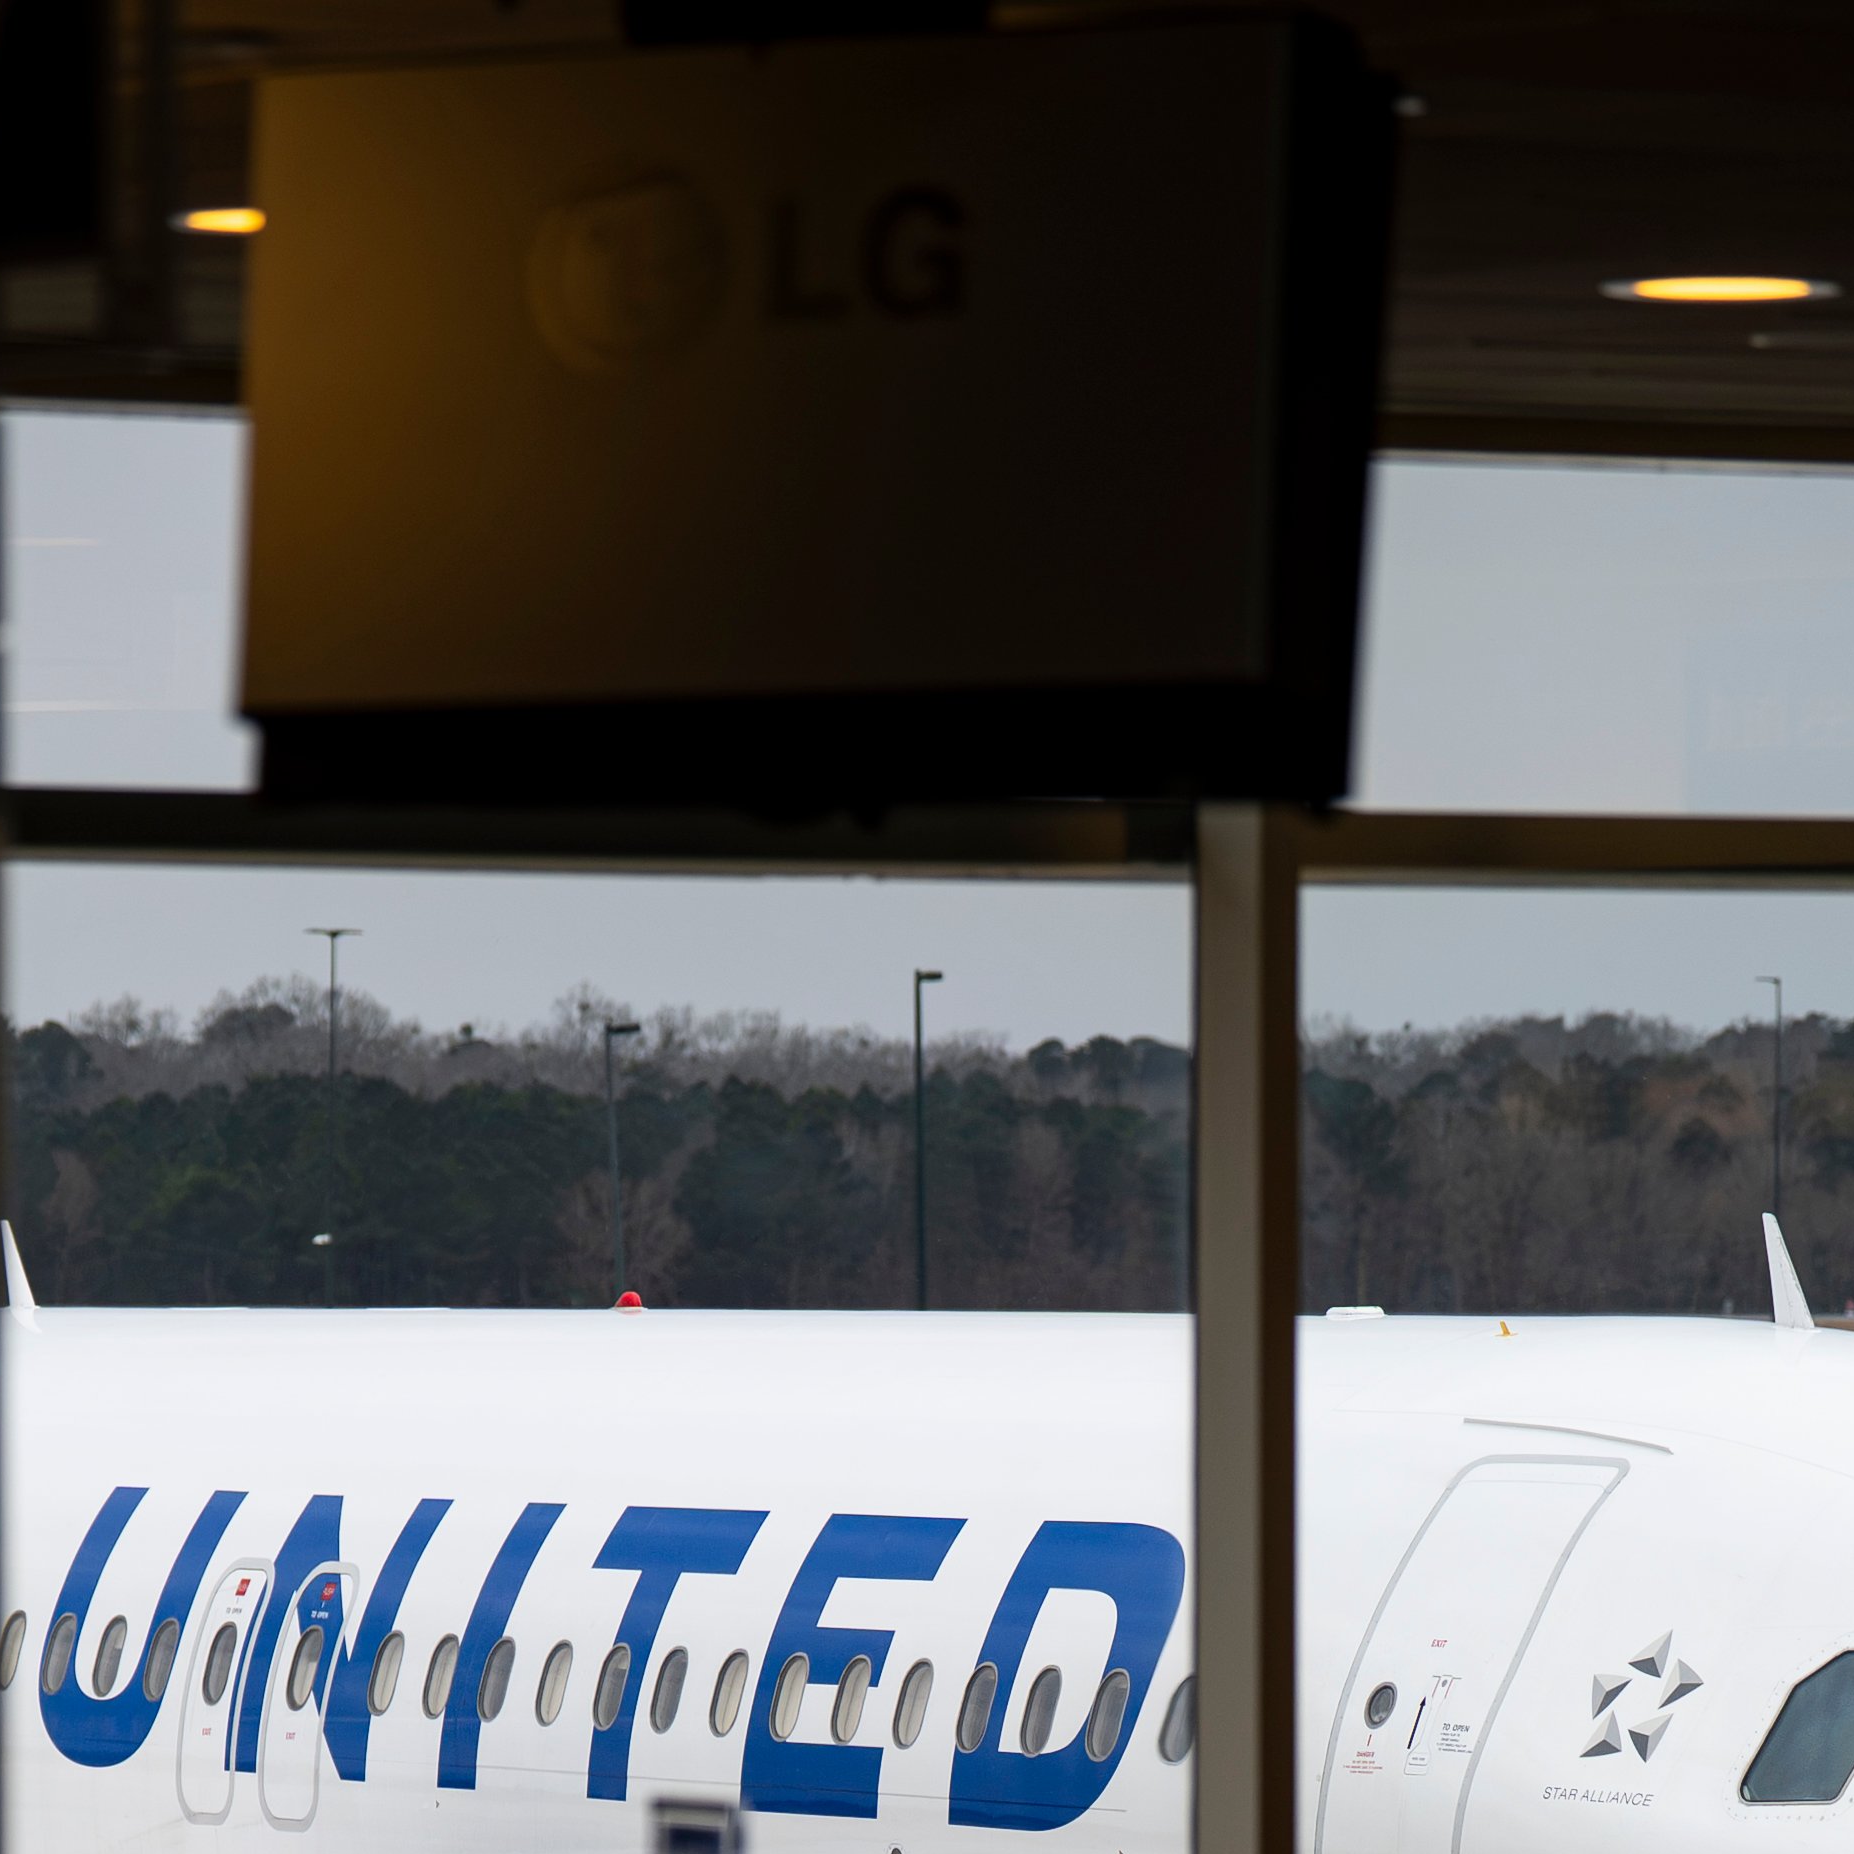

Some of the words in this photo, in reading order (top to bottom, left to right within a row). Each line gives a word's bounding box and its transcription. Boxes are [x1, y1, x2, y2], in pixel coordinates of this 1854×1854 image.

[764, 183, 969, 321] LG
[1431, 1639, 1448, 1648] EXIT
[39, 1486, 1185, 1831] UNITED
[1442, 1723, 1450, 1731] TO
[1452, 1724, 1470, 1733] OPEN
[1542, 1786, 1578, 1801] STAR
[1580, 1789, 1654, 1807] ALLIANCE
